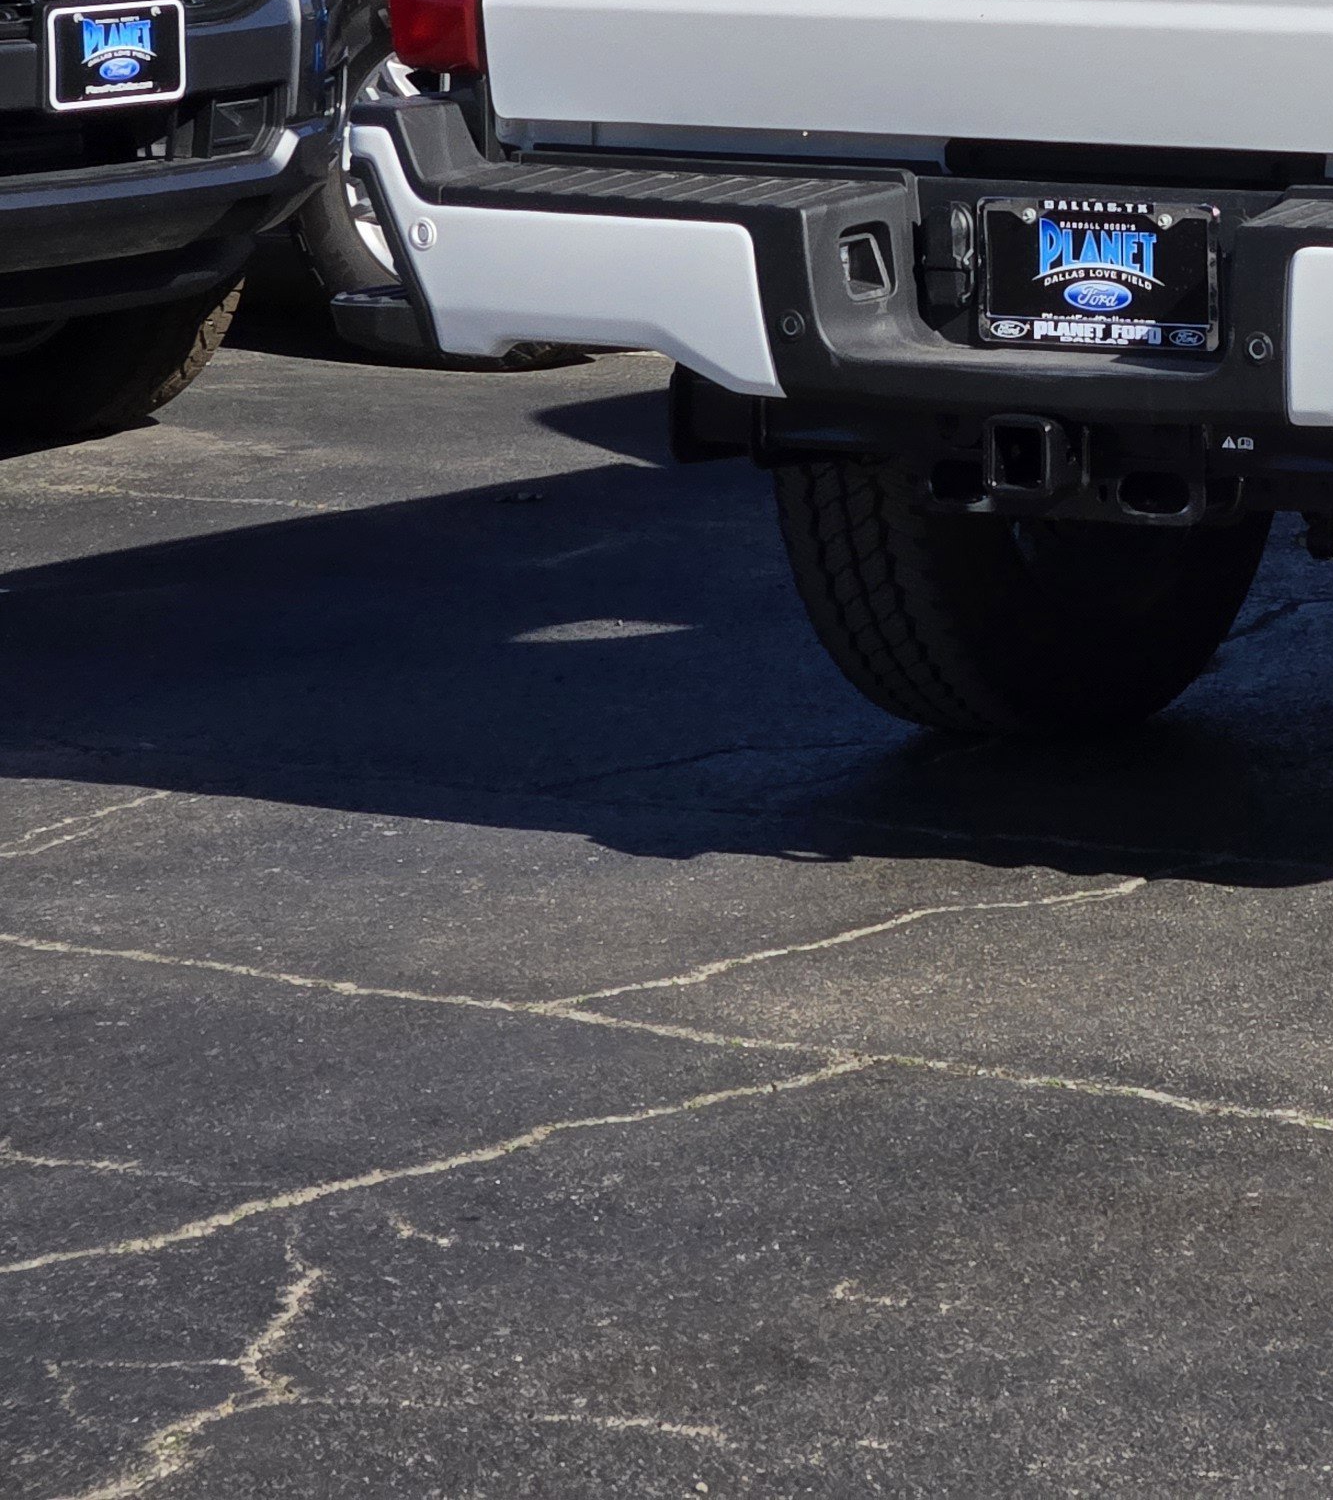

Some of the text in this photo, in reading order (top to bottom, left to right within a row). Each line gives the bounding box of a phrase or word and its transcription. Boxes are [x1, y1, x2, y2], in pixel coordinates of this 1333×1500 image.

[82, 18, 151, 61] PLANET
[1125, 203, 1148, 213] TX
[1039, 218, 1157, 278] PLANET
[1044, 269, 1152, 291] DALLAS LOVE FIELD
[1077, 285, 1118, 307] Ford
[1034, 320, 1162, 344] PLANET FORD
